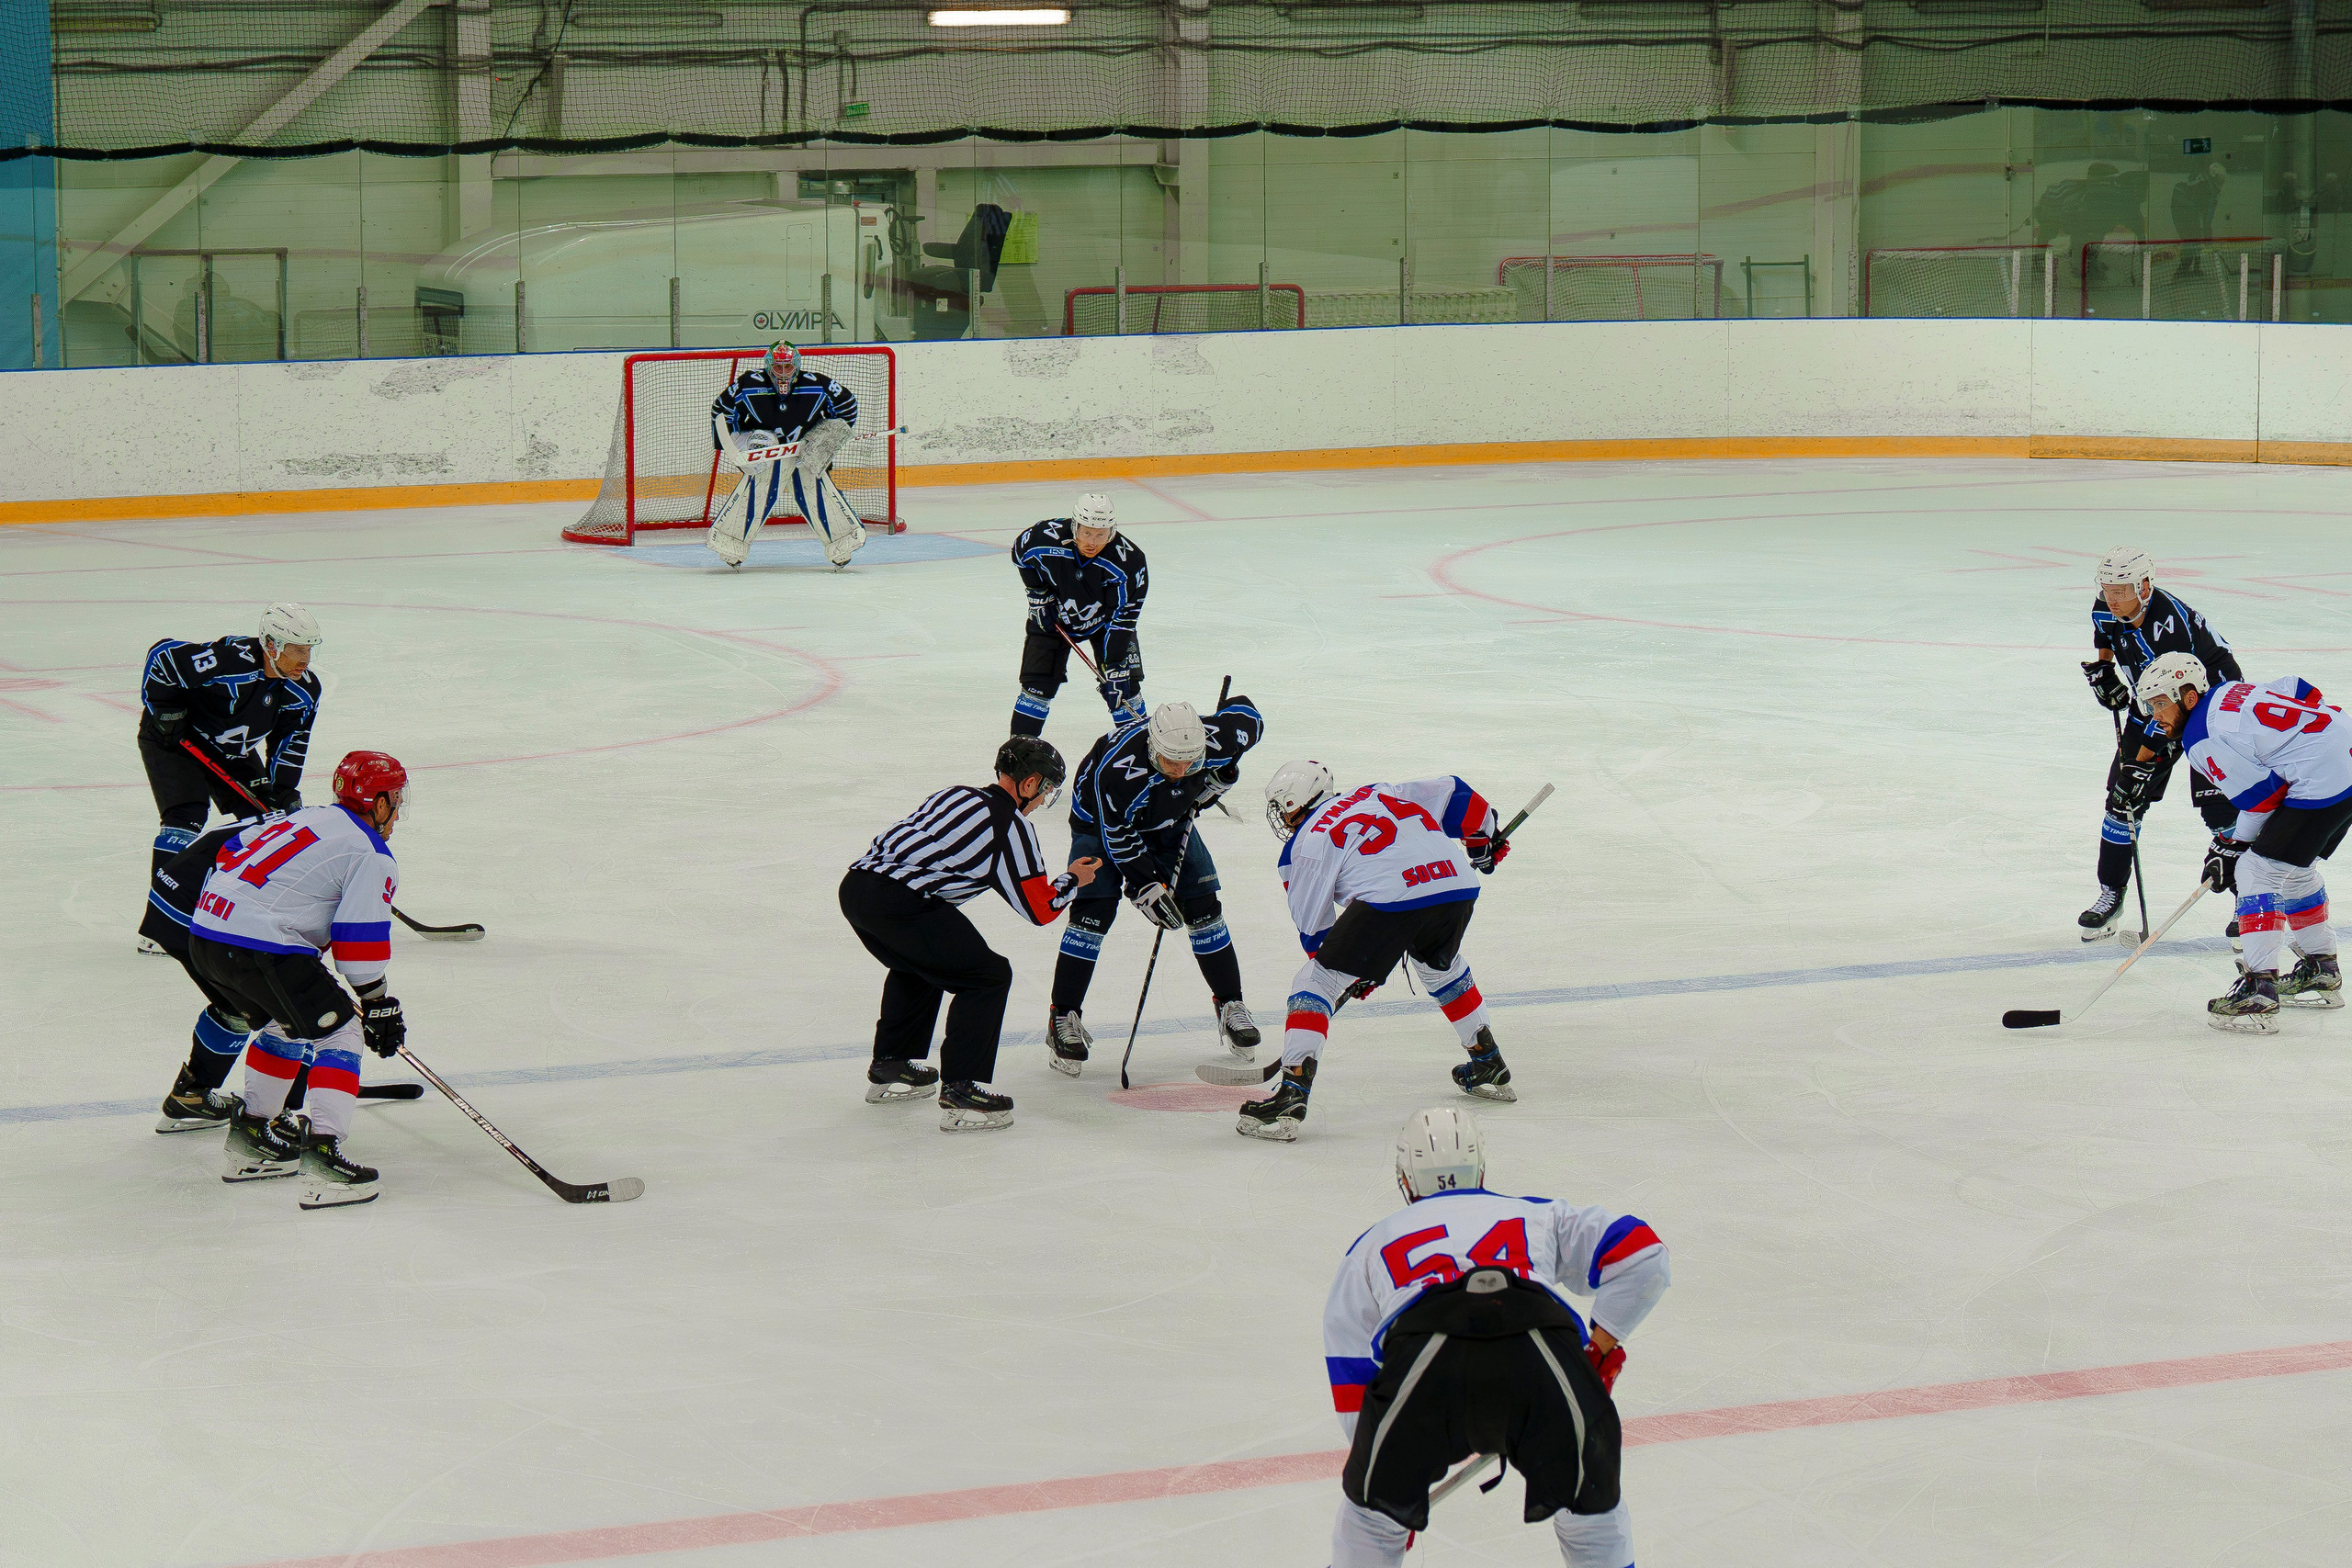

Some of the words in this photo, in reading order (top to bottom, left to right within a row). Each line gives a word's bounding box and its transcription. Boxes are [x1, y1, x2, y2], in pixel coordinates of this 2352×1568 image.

[753, 312, 846, 330] OLYMPA
[748, 445, 797, 462] CCM
[718, 493, 740, 525] TRUE
[831, 492, 854, 525] TRUE
[1029, 595, 1056, 604] BAUE
[190, 649, 218, 673] 13
[1236, 728, 1249, 746] 8
[1329, 793, 1443, 855] 34
[220, 820, 322, 890] 91
[2210, 843, 2247, 858] AUER
[156, 868, 179, 891] IMER
[1402, 860, 1458, 887] SOCHI
[1069, 939, 1086, 948] ONE
[1196, 937, 1212, 945] ONE
[368, 1006, 401, 1019] BAU
[275, 1127, 297, 1138] BAUER
[258, 1145, 280, 1158] BAUER
[333, 1164, 357, 1178] BAUER
[1437, 1174, 1457, 1190] 54
[1380, 1217, 1534, 1290] 54
